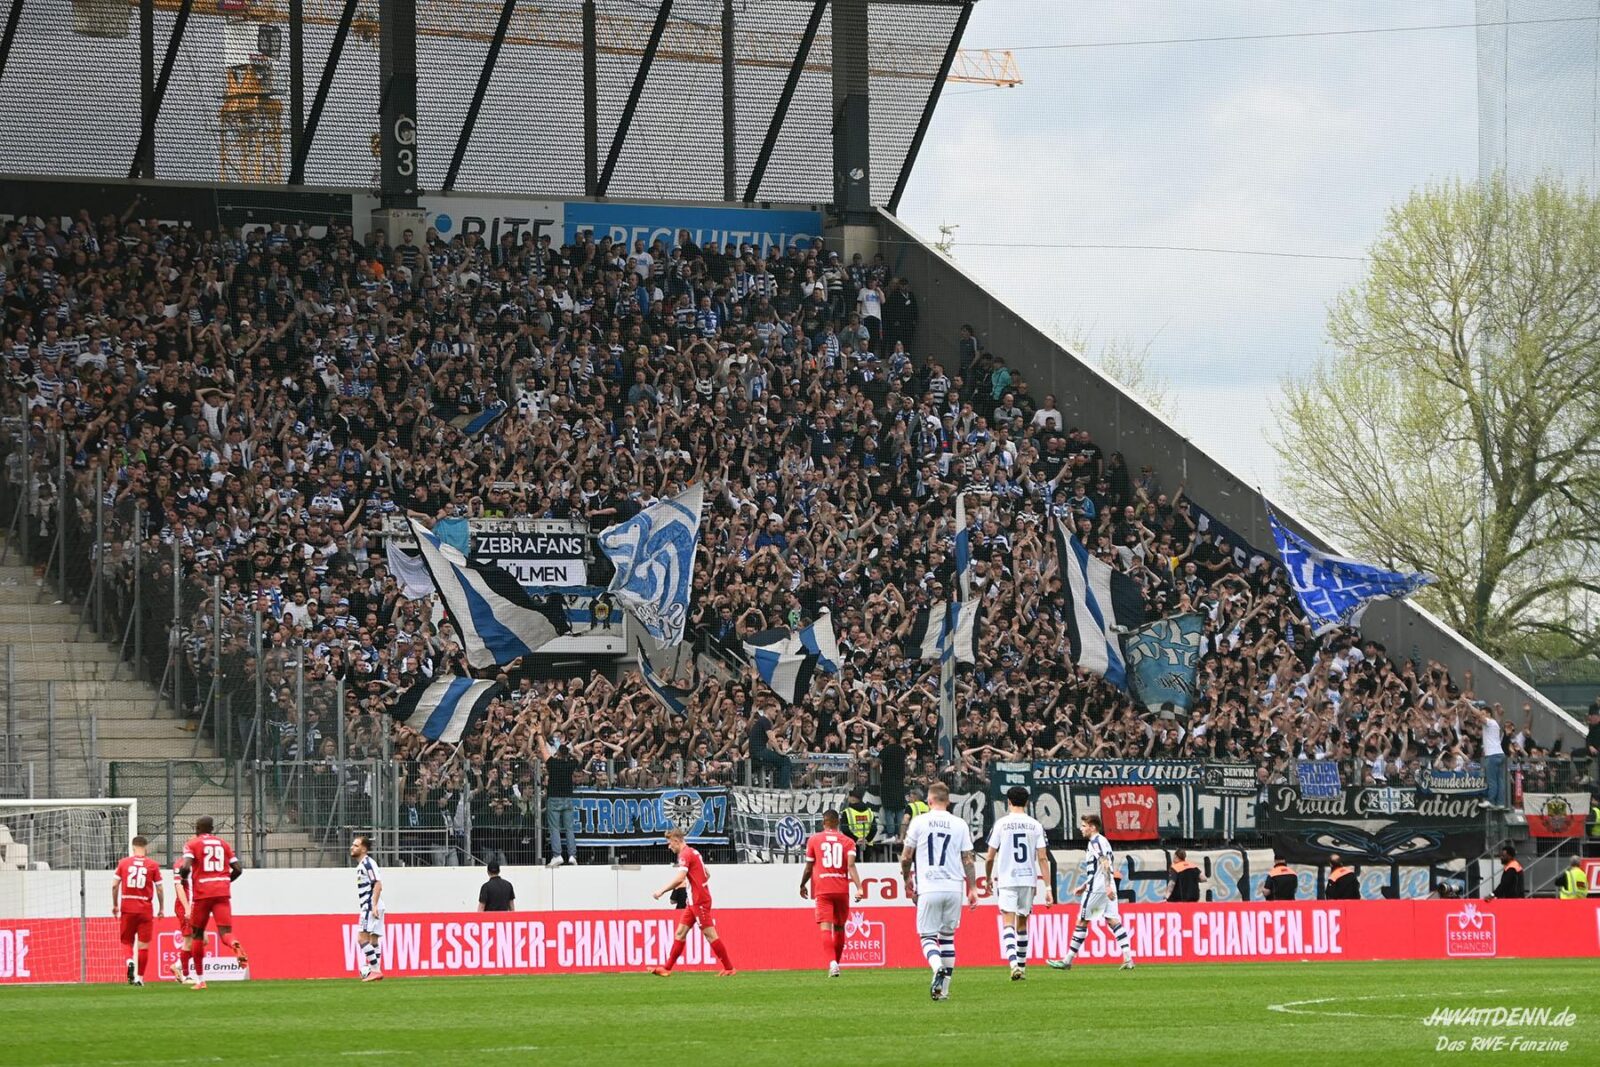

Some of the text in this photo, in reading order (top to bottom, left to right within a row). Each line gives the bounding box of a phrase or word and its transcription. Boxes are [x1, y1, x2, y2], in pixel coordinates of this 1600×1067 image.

[395, 117, 416, 145] G
[397, 149, 413, 175] 3
[576, 225, 812, 261] -RECUITIN
[477, 537, 582, 554] ZEBRAFANS
[505, 563, 568, 582] ÜLMEN
[1421, 769, 1490, 789] Freundeskrei
[733, 792, 846, 815] RUHRPOTT
[1103, 792, 1154, 810] ULTRAS
[1275, 787, 1348, 815] Proud
[572, 795, 728, 834] ETROPOL 47
[1115, 810, 1141, 830] MZ
[203, 845, 225, 872] 29
[820, 842, 843, 869] 30
[927, 832, 951, 867] 17
[1013, 833, 1028, 863] 5
[126, 865, 148, 889] 26
[843, 940, 881, 950] SENER
[1450, 931, 1492, 941] ESSENER
[1450, 941, 1492, 951] CHANCEN
[841, 951, 881, 960] HANCEN
